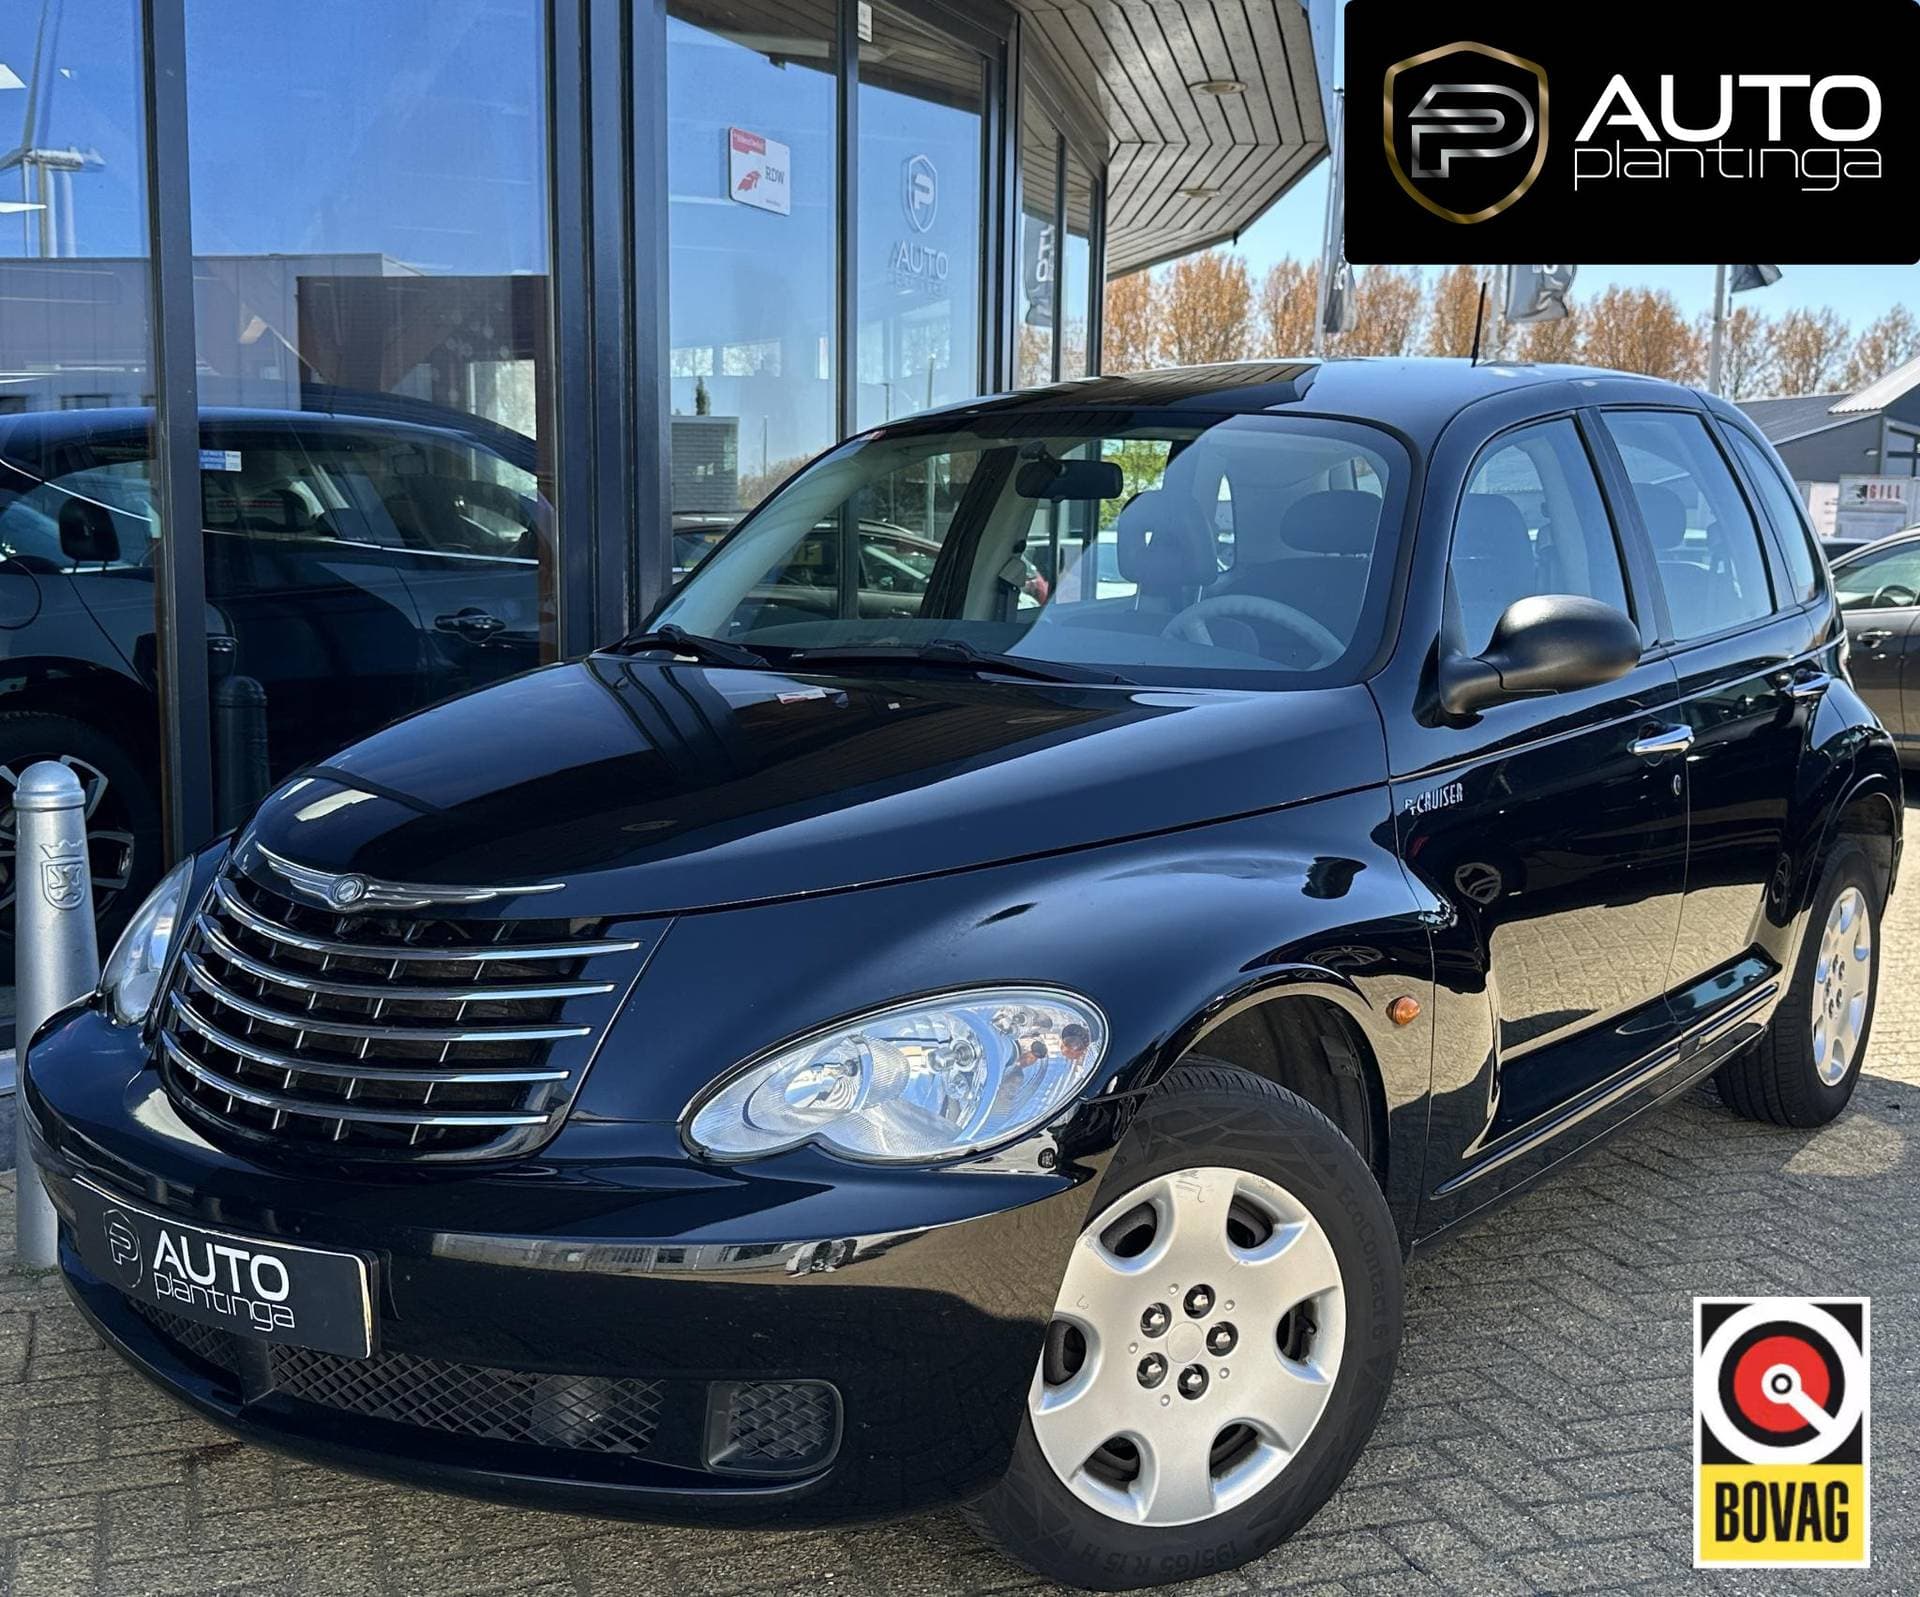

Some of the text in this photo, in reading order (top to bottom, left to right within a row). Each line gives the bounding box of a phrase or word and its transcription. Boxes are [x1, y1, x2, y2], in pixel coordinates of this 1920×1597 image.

[896, 239, 949, 280] AUTO
[1416, 783, 1464, 814] CRUISER
[153, 1229, 290, 1302] AUTO
[153, 1270, 296, 1332] plantinga
